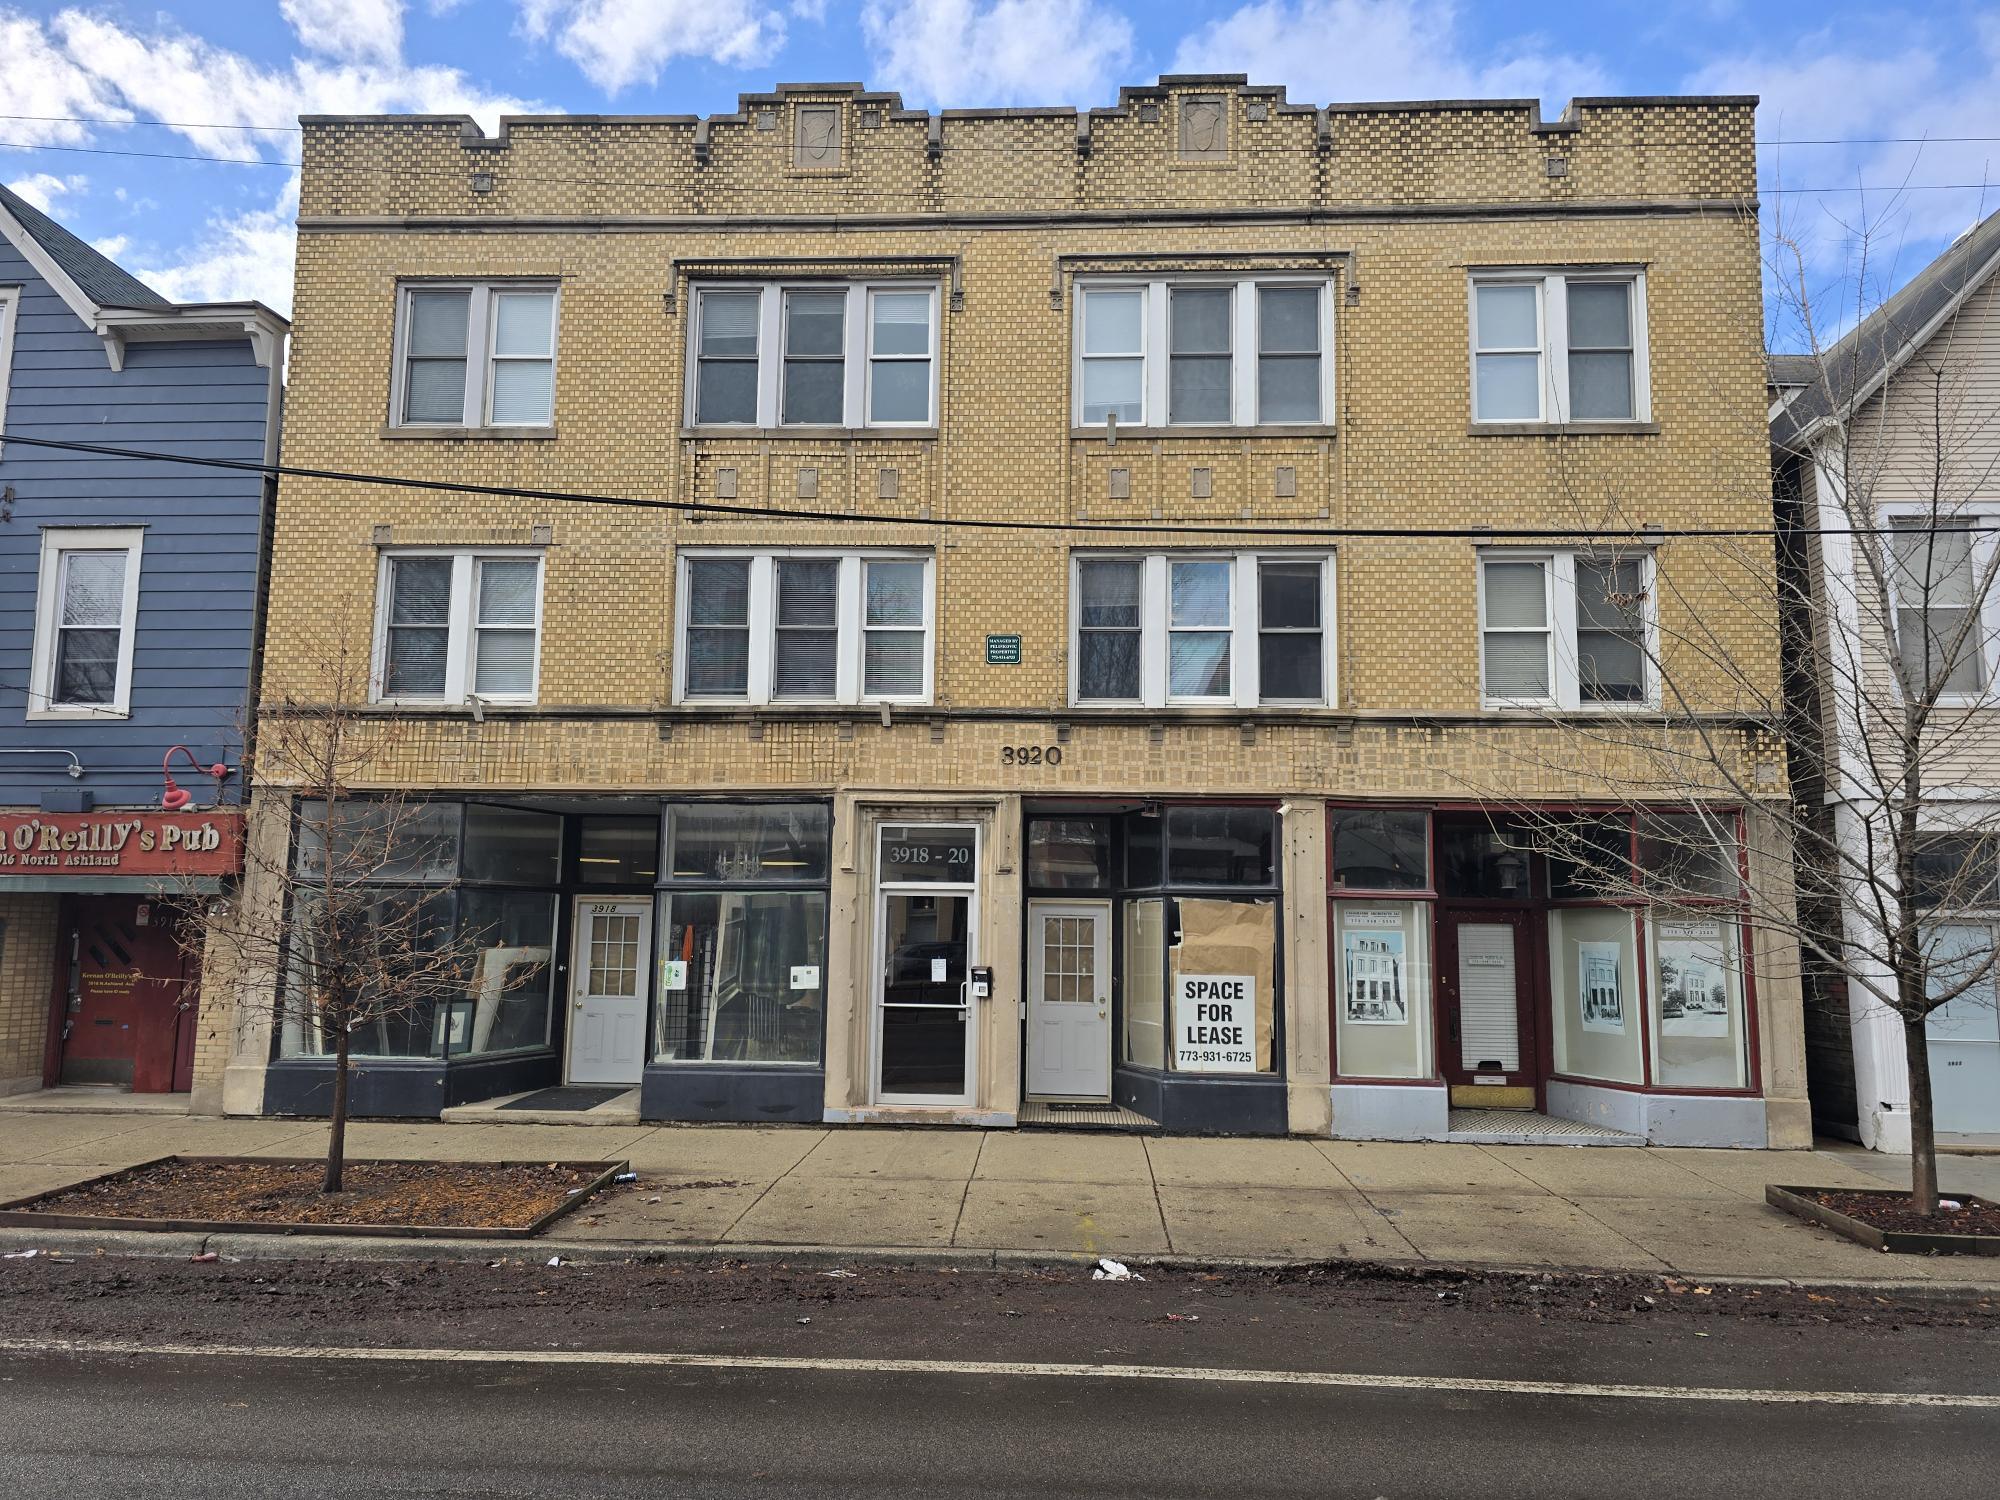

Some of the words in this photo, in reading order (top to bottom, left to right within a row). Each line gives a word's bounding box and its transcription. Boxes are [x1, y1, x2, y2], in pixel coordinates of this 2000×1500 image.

[1001, 746, 1062, 765] 3920
[13, 819, 154, 851] O'Reilly's
[160, 822, 220, 850] Pub
[20, 853, 59, 865] North
[64, 853, 119, 866] Ashland
[890, 847, 929, 863] 3918
[948, 847, 969, 864] 20
[591, 904, 617, 913] 3918
[1185, 981, 1244, 999] SPACE
[1197, 1003, 1233, 1022] FOR
[1187, 1026, 1243, 1045] LEASE
[1179, 1050, 1252, 1063] 773-931-6725
